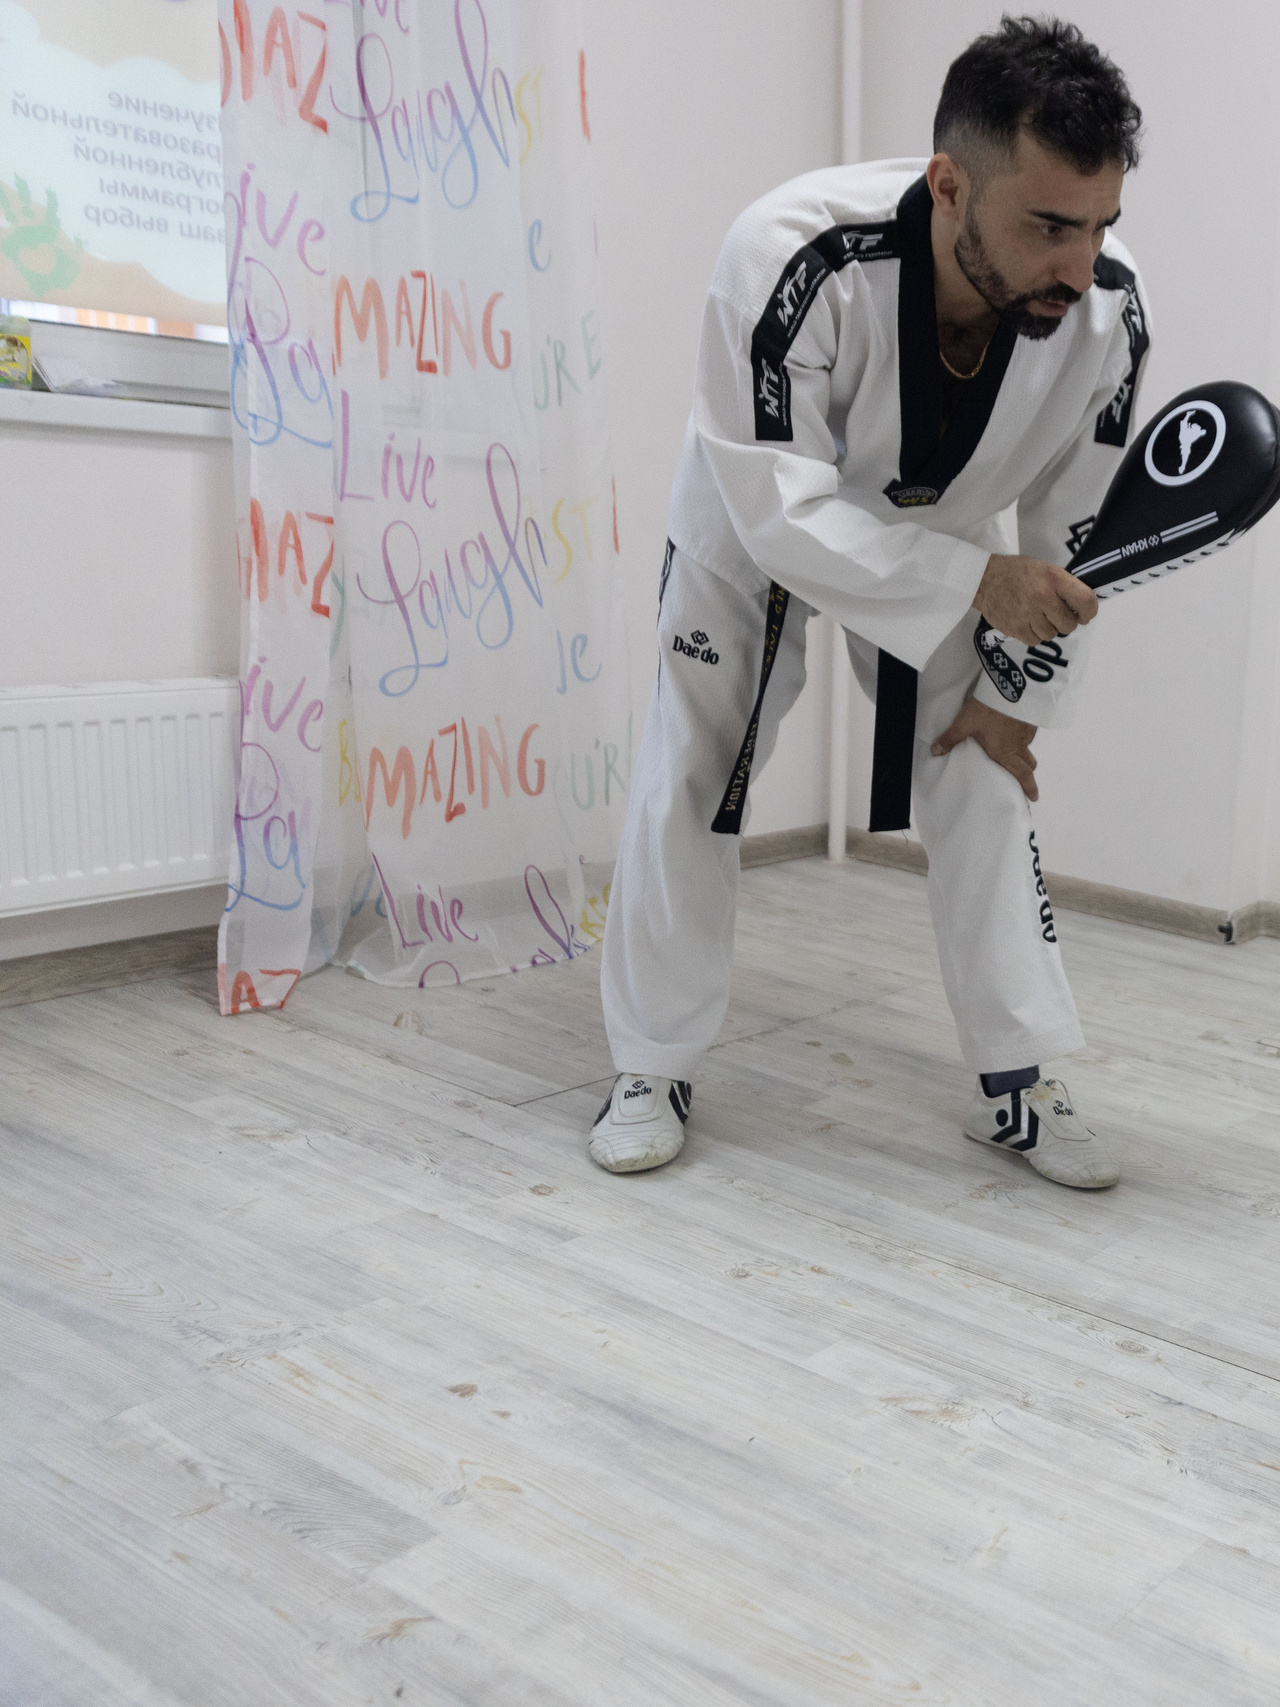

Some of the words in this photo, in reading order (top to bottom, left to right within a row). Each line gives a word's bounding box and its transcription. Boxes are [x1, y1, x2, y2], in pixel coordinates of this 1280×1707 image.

[777, 261, 807, 327] WTF
[758, 357, 781, 419] WTF
[340, 388, 436, 509] Live
[356, 442, 547, 697] Laugh
[1121, 538, 1149, 558] KHAN
[673, 634, 720, 665] Daedo
[365, 713, 546, 840] MAZING
[372, 852, 478, 949] Live
[624, 1086, 652, 1099] Daedo
